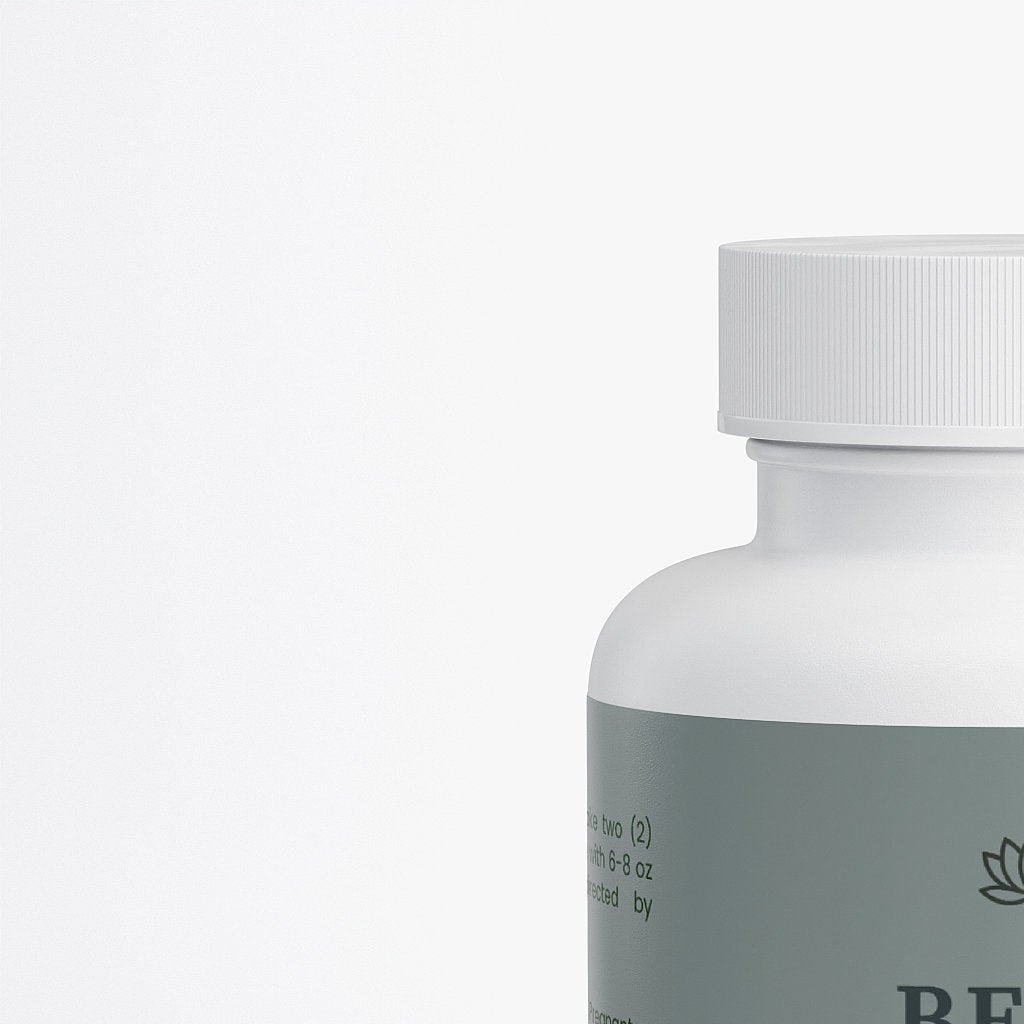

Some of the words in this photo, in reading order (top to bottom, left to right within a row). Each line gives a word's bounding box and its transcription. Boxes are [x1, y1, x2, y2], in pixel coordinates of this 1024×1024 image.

[602, 814, 623, 838] two
[631, 814, 652, 850] (2)
[609, 850, 631, 876] 6-8
[636, 862, 653, 880] oz
[634, 890, 653, 922] by
